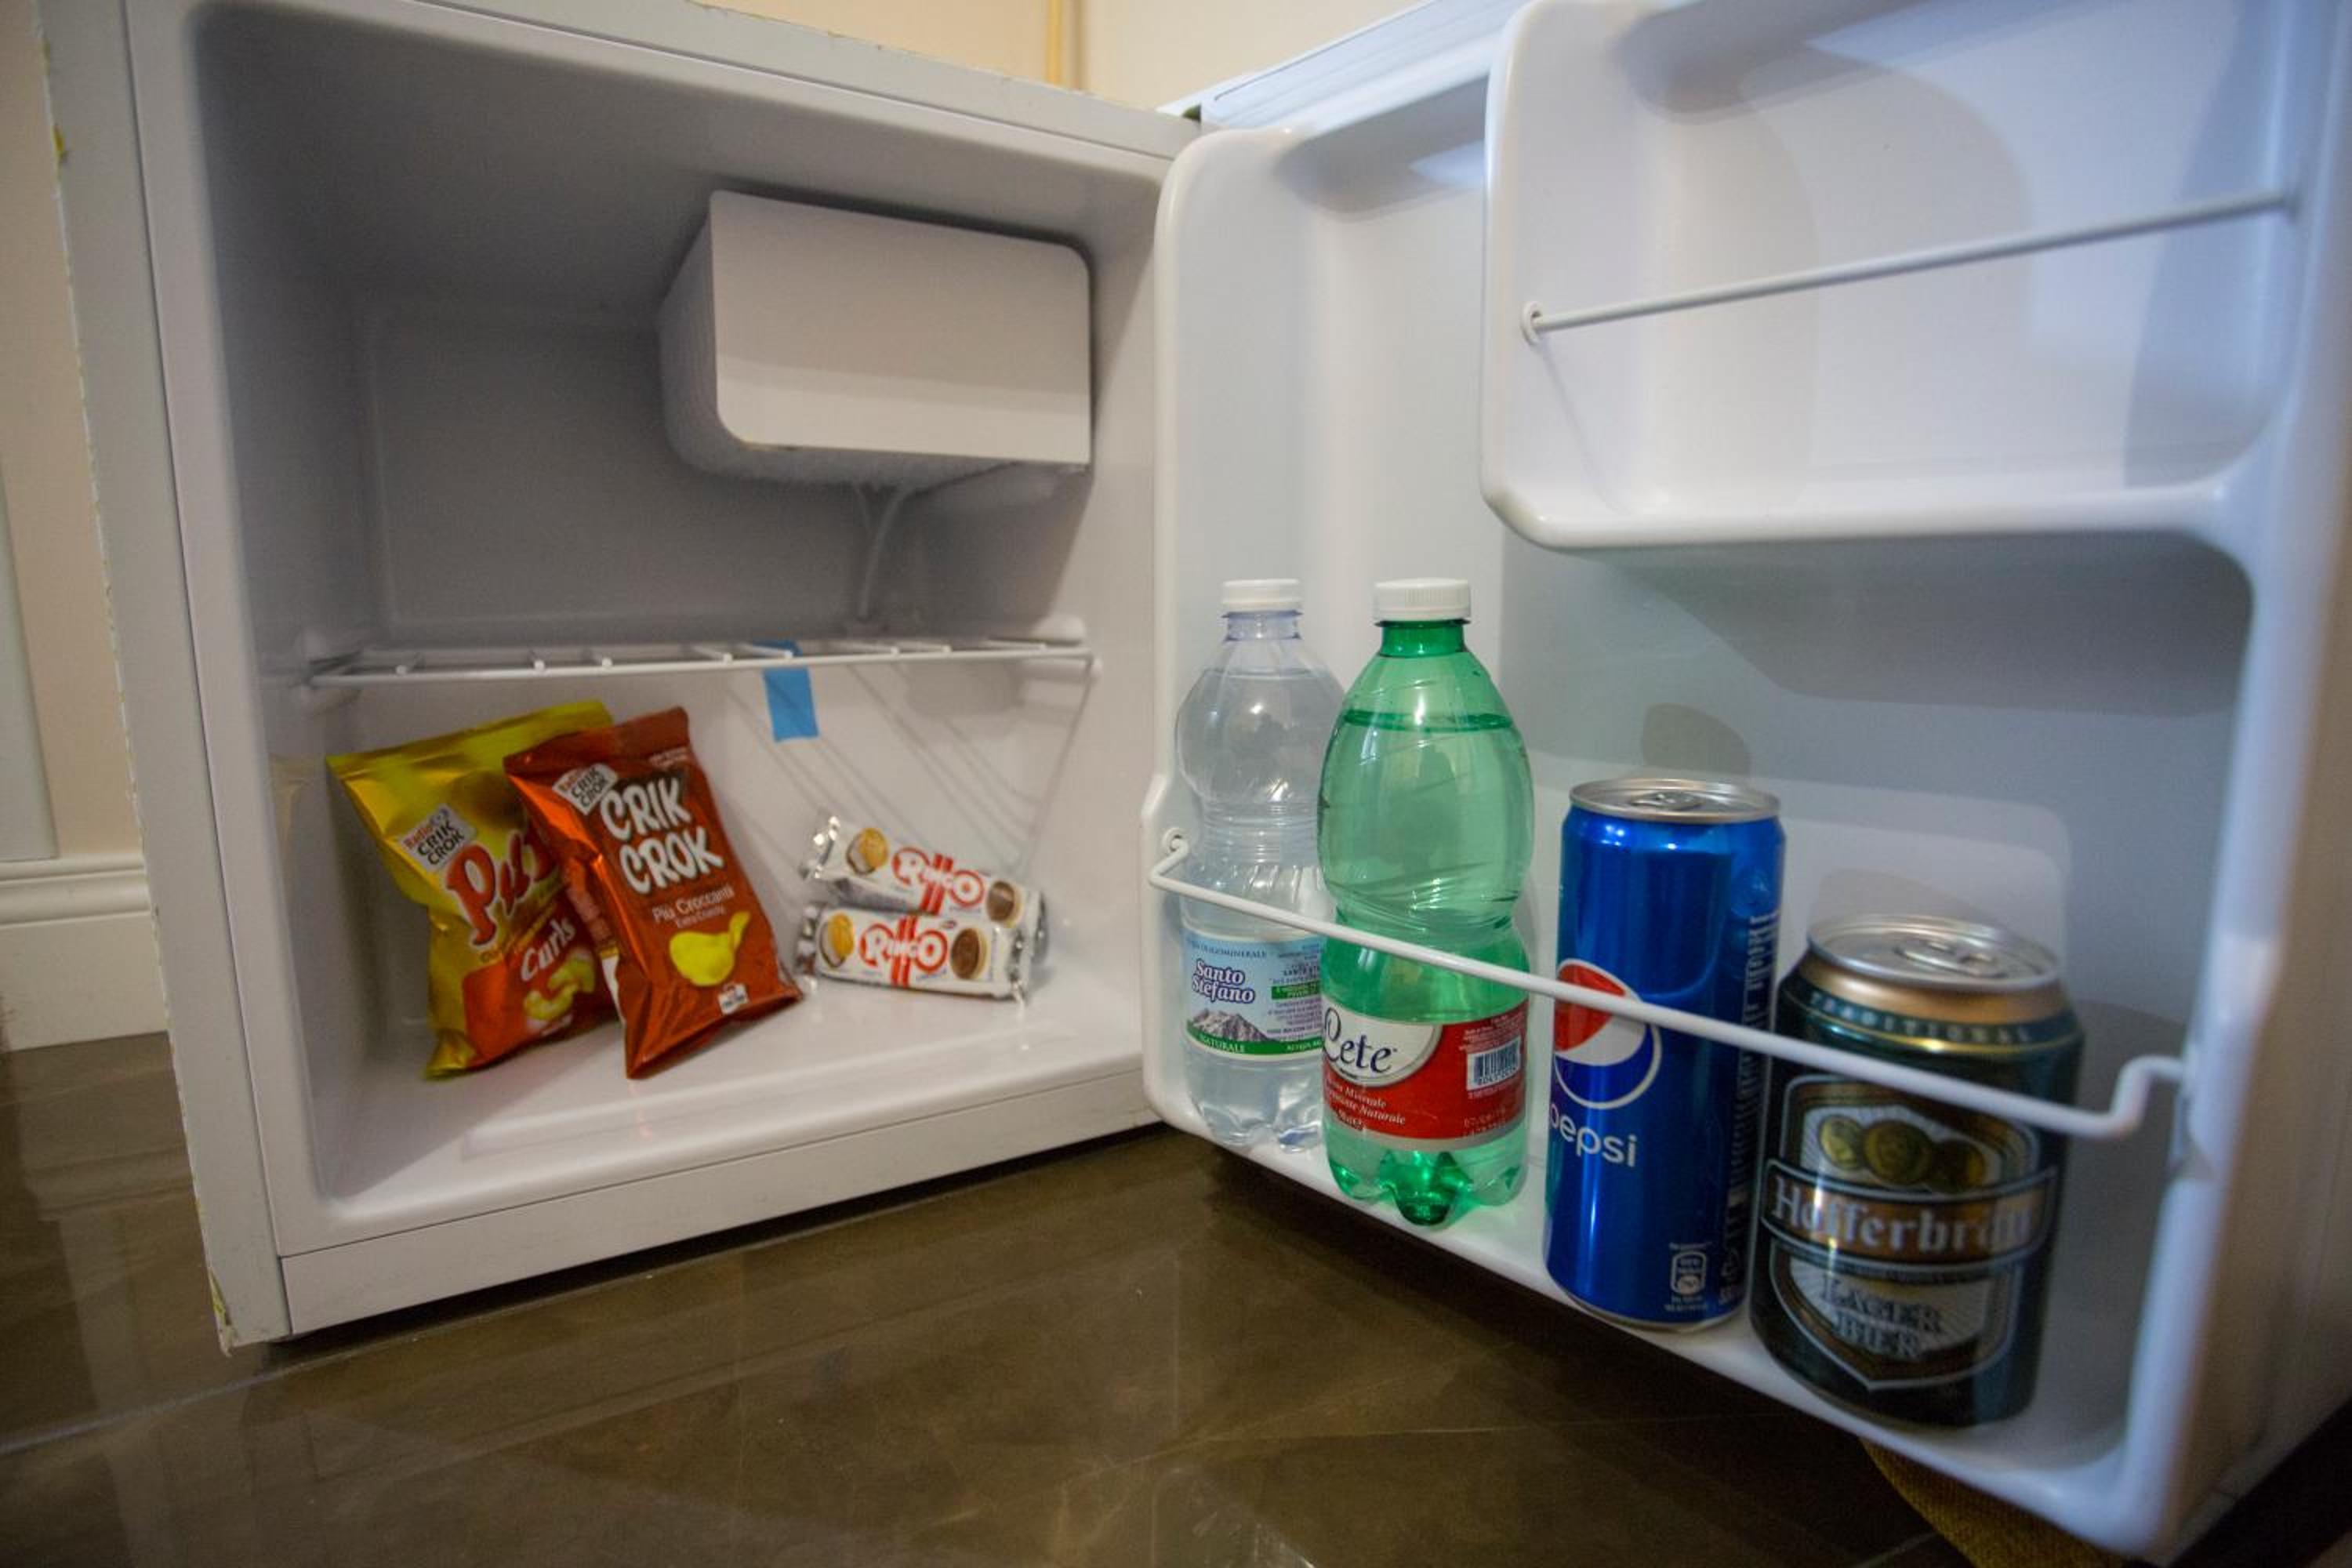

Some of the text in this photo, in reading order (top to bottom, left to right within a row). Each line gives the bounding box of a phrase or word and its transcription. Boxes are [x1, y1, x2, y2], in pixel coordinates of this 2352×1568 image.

[572, 766, 600, 797] CRIK
[580, 776, 608, 808] CROK
[601, 777, 691, 841] CRIK
[417, 819, 455, 855] CRIK
[428, 829, 465, 864] CROK
[619, 826, 723, 894] CROK
[521, 917, 576, 981] Curls
[1192, 972, 1255, 1004] Stefano
[1196, 958, 1245, 985] Santo
[1550, 1103, 1637, 1167] pepsi
